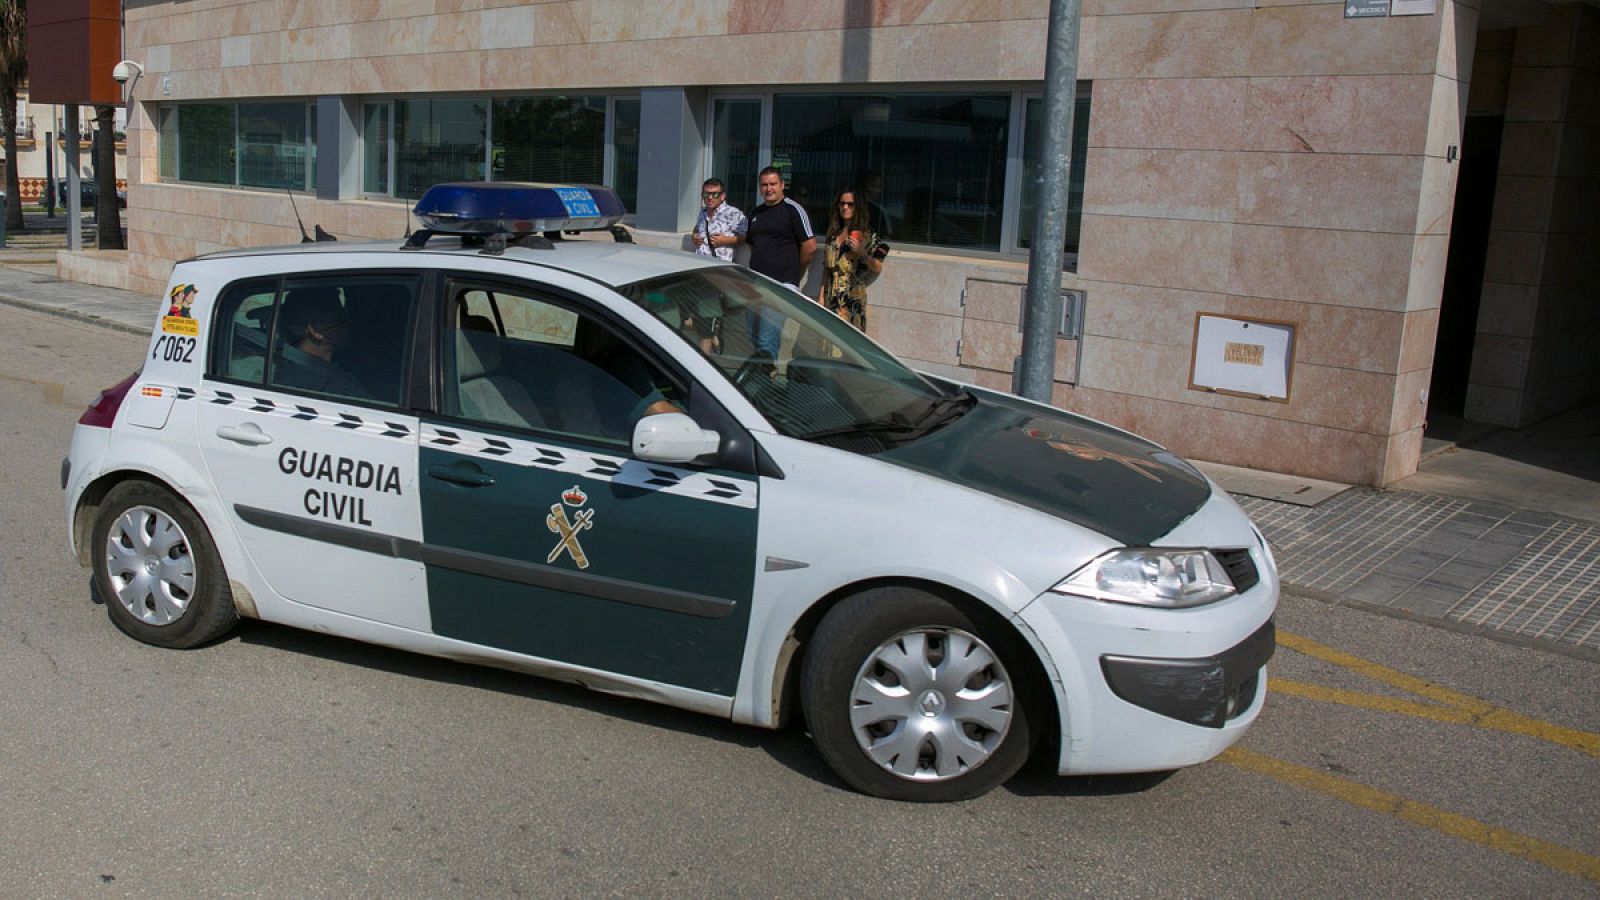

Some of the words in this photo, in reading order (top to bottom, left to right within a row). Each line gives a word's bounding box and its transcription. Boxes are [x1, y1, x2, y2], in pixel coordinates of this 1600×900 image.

[559, 190, 593, 201] GUARDIA
[573, 202, 593, 214] CIVIL
[164, 335, 197, 363] 062
[278, 447, 402, 496] GUARDIA
[303, 488, 373, 526] CIVIL
